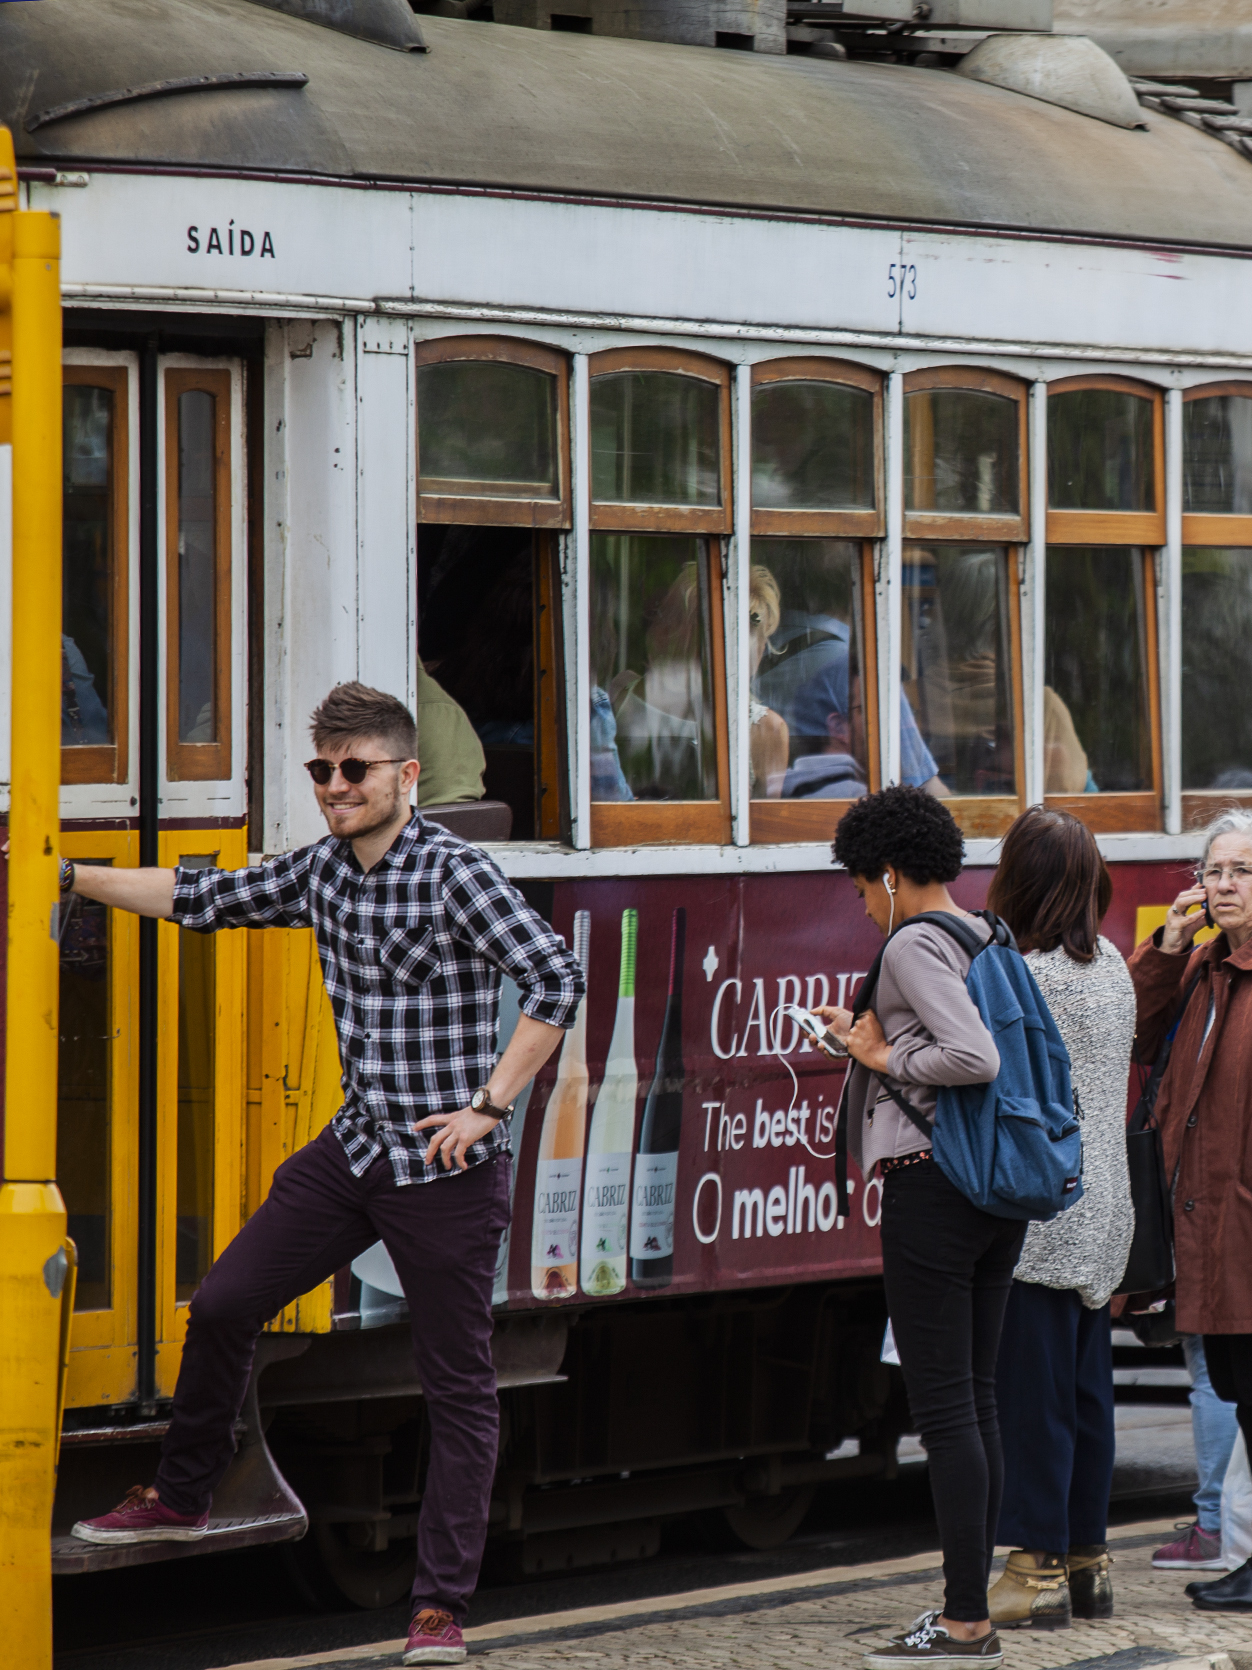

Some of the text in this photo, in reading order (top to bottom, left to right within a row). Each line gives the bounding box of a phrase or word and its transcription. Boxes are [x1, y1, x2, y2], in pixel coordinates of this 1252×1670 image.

[187, 219, 275, 259] SAÍDA
[887, 263, 917, 300] 573
[702, 1095, 835, 1152] The best is
[538, 1190, 577, 1214] CABRIZ
[587, 1184, 626, 1208] CABRIZ
[636, 1183, 674, 1207] CABRIZ
[692, 1172, 723, 1244] O
